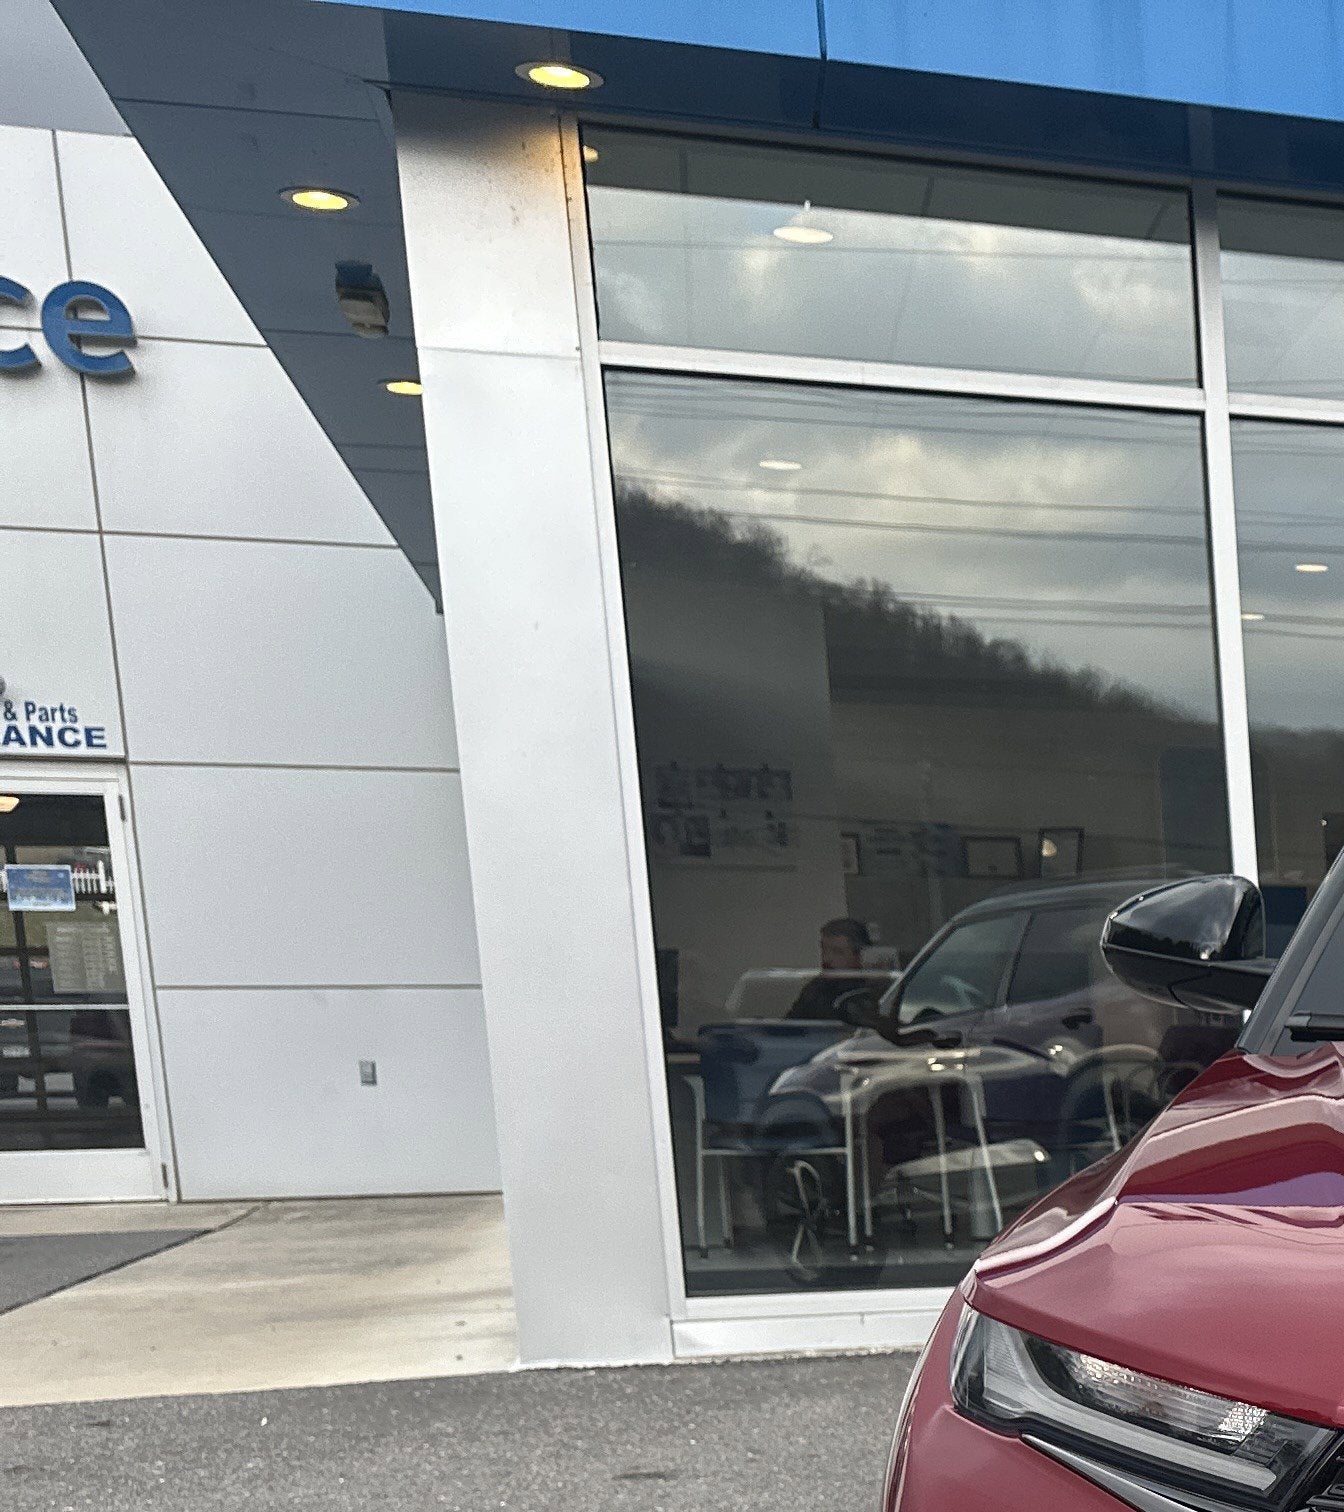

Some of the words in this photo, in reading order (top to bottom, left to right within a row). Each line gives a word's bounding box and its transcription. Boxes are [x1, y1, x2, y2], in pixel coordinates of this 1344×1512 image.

[3, 699, 18, 721] &
[24, 700, 78, 723] Parts
[2, 723, 107, 749] ANCE
